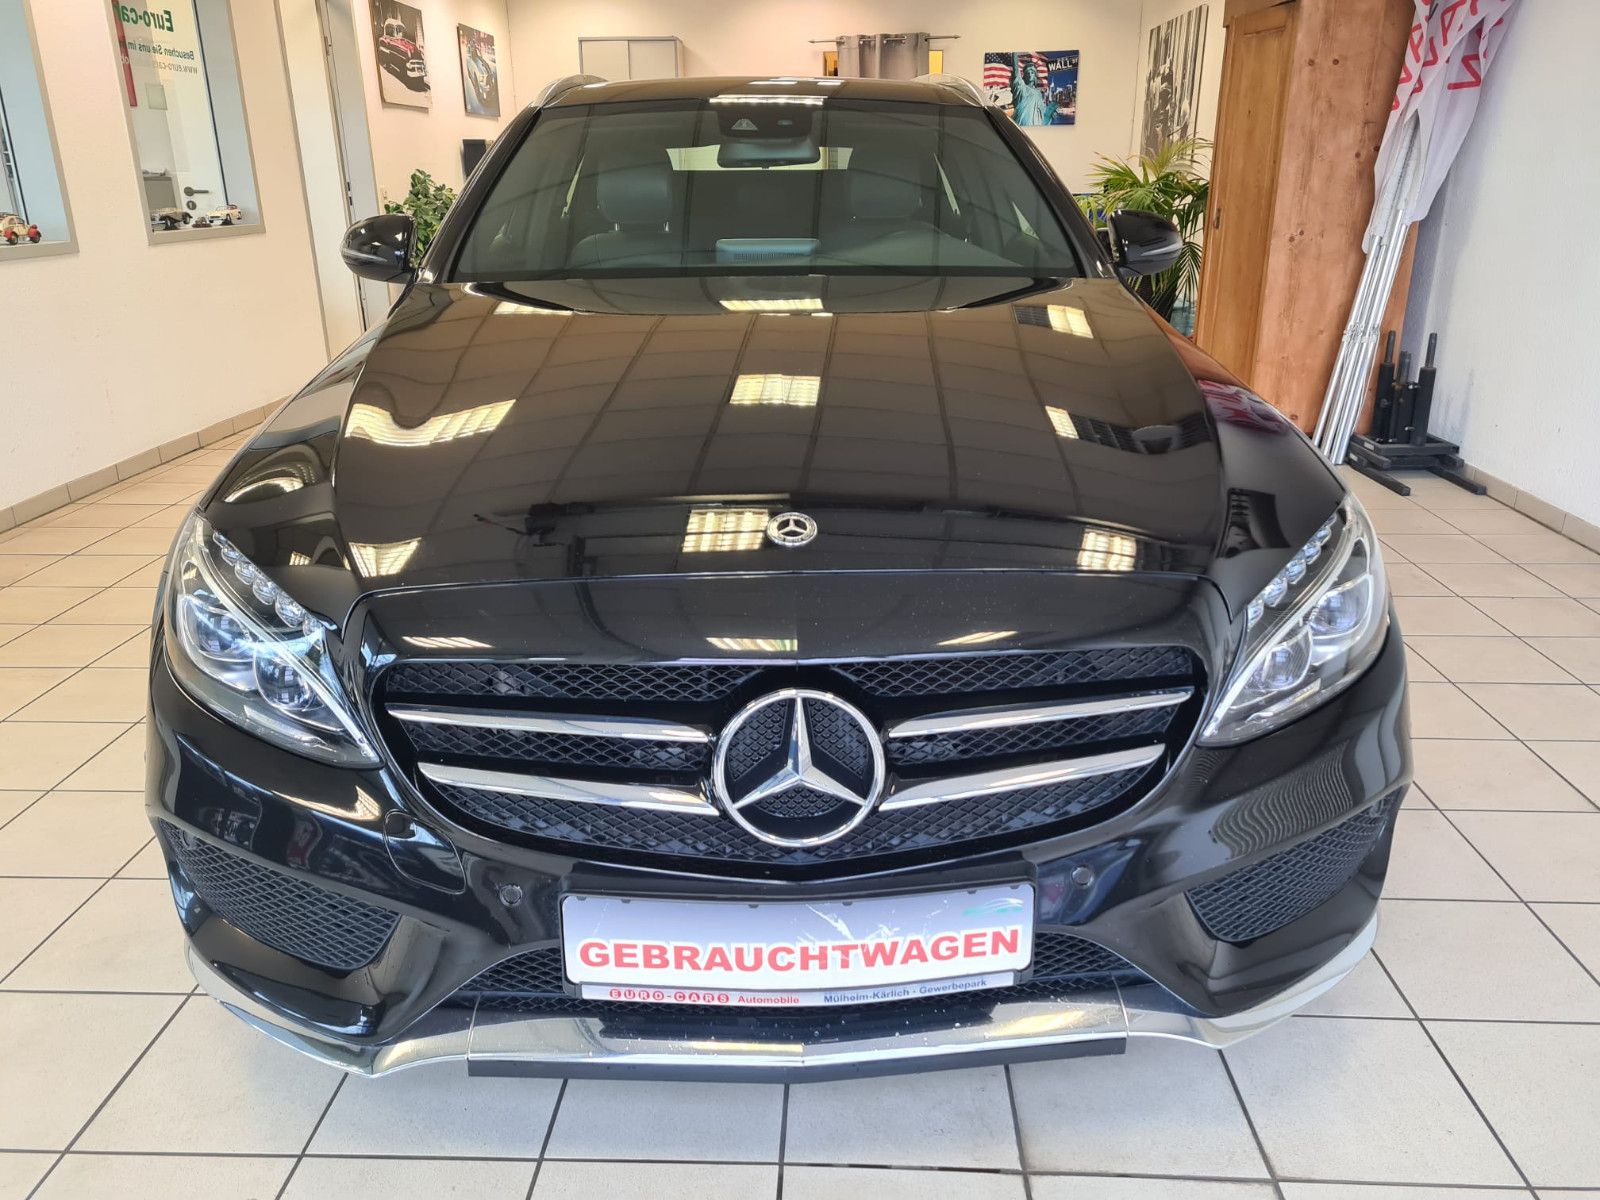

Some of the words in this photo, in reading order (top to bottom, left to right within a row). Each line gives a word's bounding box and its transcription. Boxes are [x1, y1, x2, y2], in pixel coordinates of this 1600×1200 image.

[1048, 60, 1072, 71] WALL
[579, 928, 1019, 972] GEBRAUCHTWAGEN
[608, 988, 730, 1004] EURO-CARS
[737, 994, 800, 1005] Automobile
[823, 989, 910, 1003] Mülheim-Kärlich
[919, 979, 988, 995] Gewerbepark
